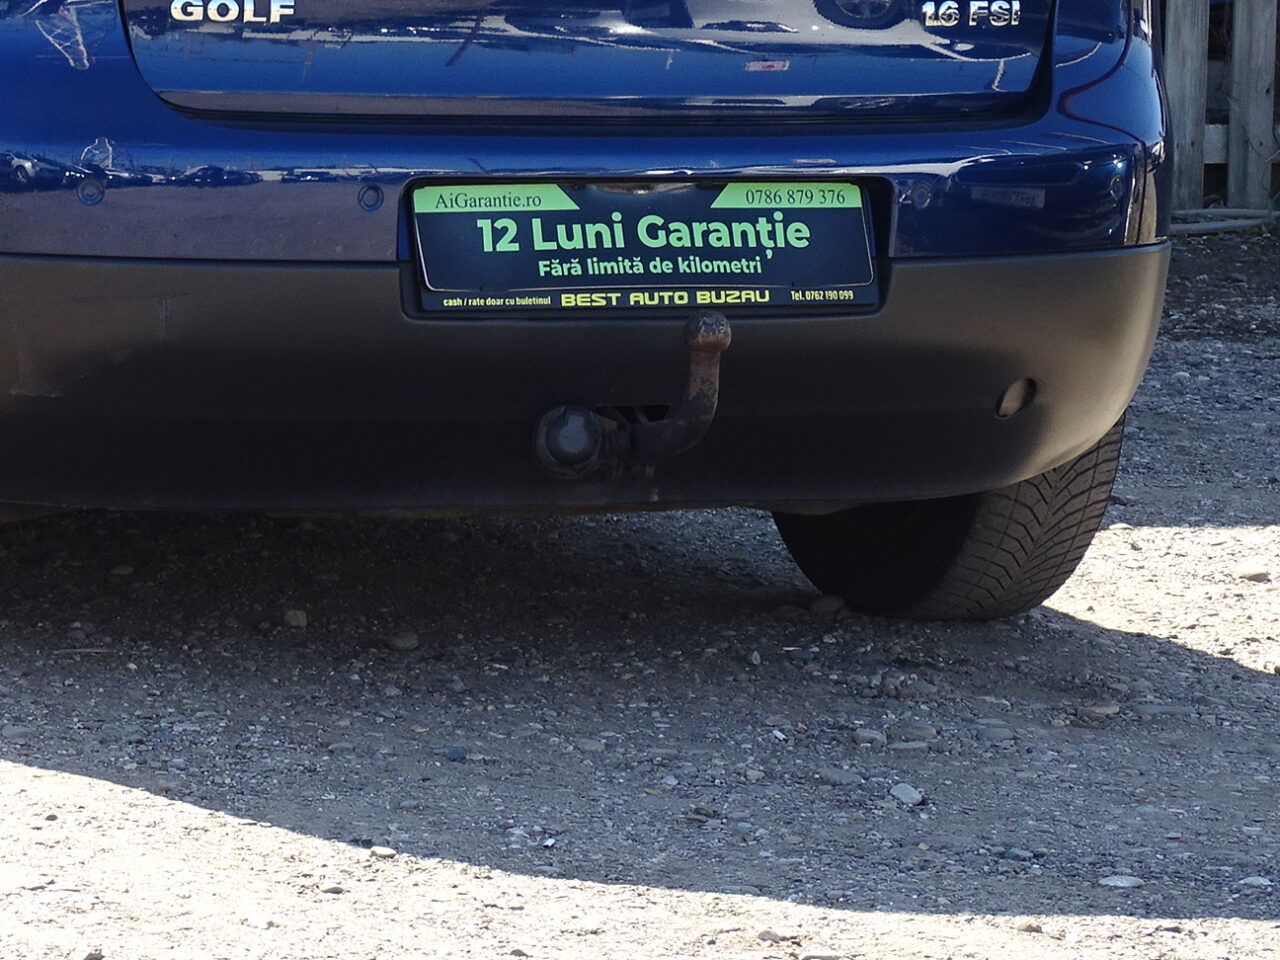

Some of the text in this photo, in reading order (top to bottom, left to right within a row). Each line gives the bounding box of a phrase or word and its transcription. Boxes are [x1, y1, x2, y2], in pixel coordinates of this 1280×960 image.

[969, 0, 1021, 26] FSI
[435, 192, 542, 209] AiGarantie.ro
[745, 189, 845, 205] 0786 879 376
[476, 211, 811, 259] 12 Luni Garanție
[538, 255, 762, 277] Fără limită de kilometri
[443, 297, 462, 307] cash
[468, 297, 485, 306] rate
[486, 296, 504, 306] doar
[505, 297, 515, 306] cu
[516, 295, 551, 305] buletinul
[561, 290, 770, 307] BEST AUTO BUZAU
[791, 291, 805, 301] Tel.
